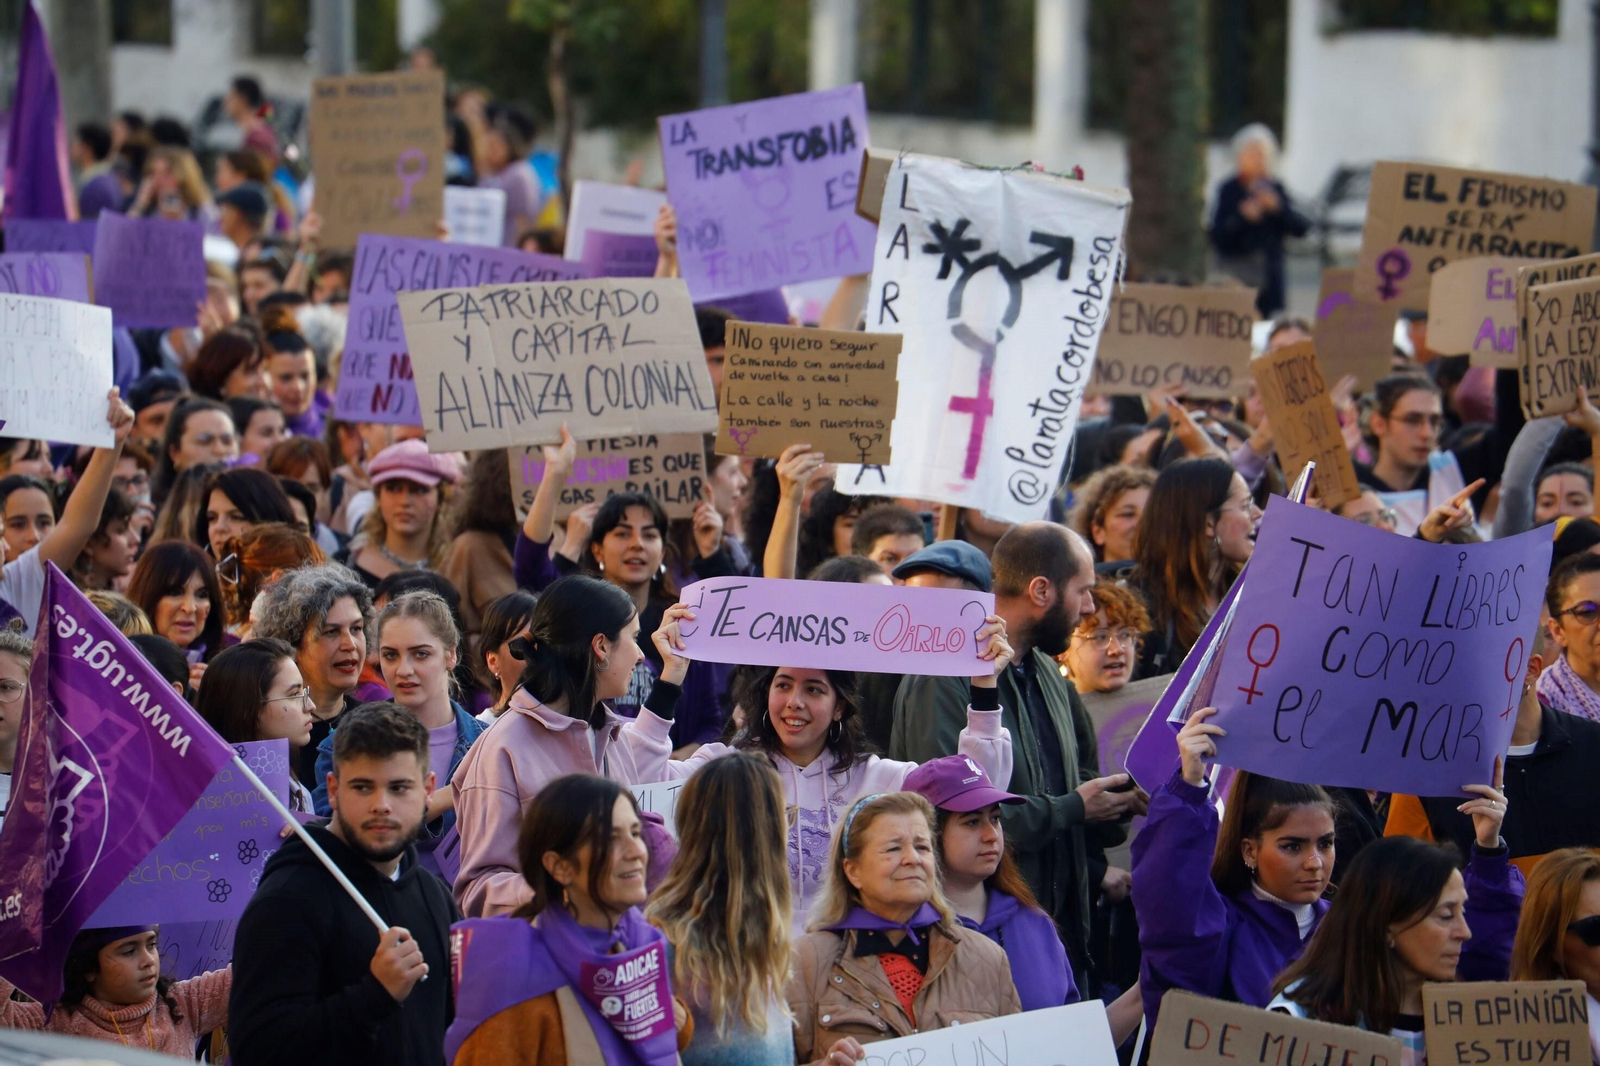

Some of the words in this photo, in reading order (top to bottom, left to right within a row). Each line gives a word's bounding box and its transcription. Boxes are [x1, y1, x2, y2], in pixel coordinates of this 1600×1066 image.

[670, 119, 697, 146] LA
[686, 116, 857, 180] TRANSFOBIA
[1404, 172, 1448, 203] EL
[356, 245, 404, 295] LAS
[1194, 307, 1253, 340] MIEDO
[453, 334, 471, 364] Y
[769, 333, 823, 356] quiero
[1534, 330, 1559, 357] LA
[1567, 325, 1598, 356] LEY
[729, 370, 745, 380] de
[750, 371, 790, 381] vuelta
[796, 374, 806, 382] a
[730, 354, 798, 368] Caminando
[829, 359, 885, 370] ansiedad
[1095, 358, 1124, 384] NO
[1131, 364, 1159, 388] LO
[1164, 361, 1232, 389] CAUSO
[1535, 355, 1600, 398] EXTRAN
[727, 386, 751, 406] La
[757, 390, 793, 407] calle
[803, 396, 811, 411] y
[818, 392, 831, 407] la
[839, 394, 879, 407] noche
[790, 418, 811, 428] son
[629, 455, 653, 476] ES
[662, 451, 701, 473] QUE
[522, 487, 596, 505] SGAS
[749, 611, 849, 647] CANSAS
[853, 630, 872, 644] DE
[51, 603, 192, 758] www.ugt.es
[194, 824, 224, 843] por
[122, 855, 211, 886] echos
[0, 892, 23, 922] .es
[614, 948, 660, 987] ADICAE
[1433, 1000, 1463, 1026] LA
[951, 1029, 1009, 1066] UN
[1184, 1017, 1242, 1058] DE
[1455, 1040, 1492, 1065] ES
[1495, 1038, 1571, 1063] TUYA
